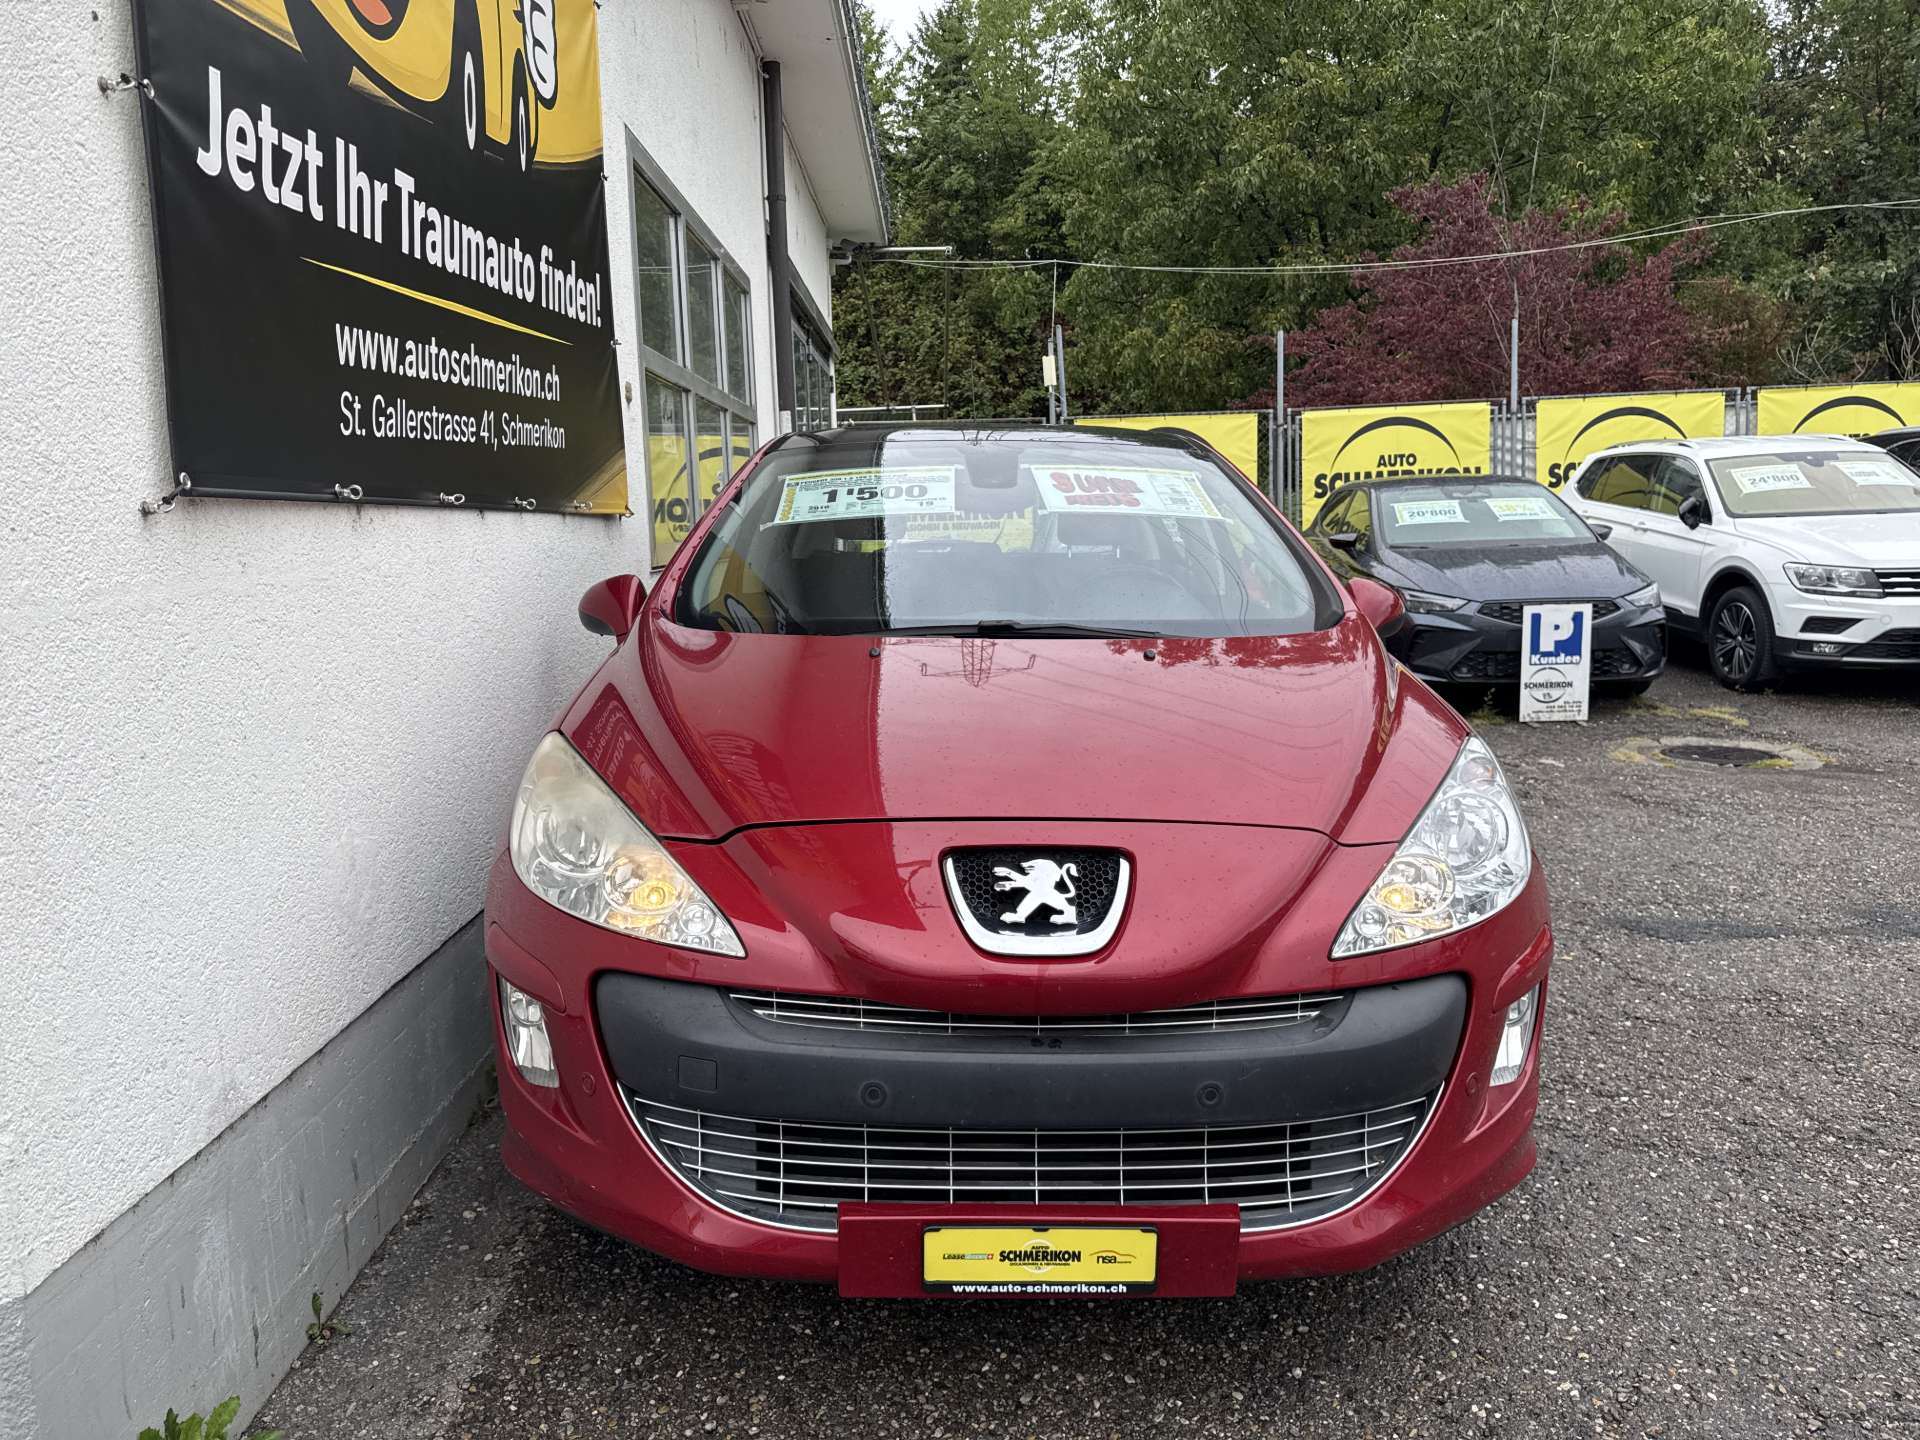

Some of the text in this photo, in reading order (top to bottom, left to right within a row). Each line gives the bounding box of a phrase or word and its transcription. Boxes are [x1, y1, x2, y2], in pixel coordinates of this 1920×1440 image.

[196, 65, 602, 328] Jetzt Ihr Traumauto finden!
[335, 322, 560, 402] www.autoschmerikon.ch
[339, 391, 565, 451] St. Gallerstrasse 41, Schmerikon
[1377, 453, 1417, 468] AUTO
[822, 484, 928, 503] 1'500
[1540, 608, 1574, 652] P
[1531, 654, 1581, 665] Kunden
[1524, 681, 1573, 690] SCHMERIKON
[999, 1250, 1082, 1262] SCHMERIKON
[952, 1284, 1127, 1293] www.auto-schmerikon.ch
